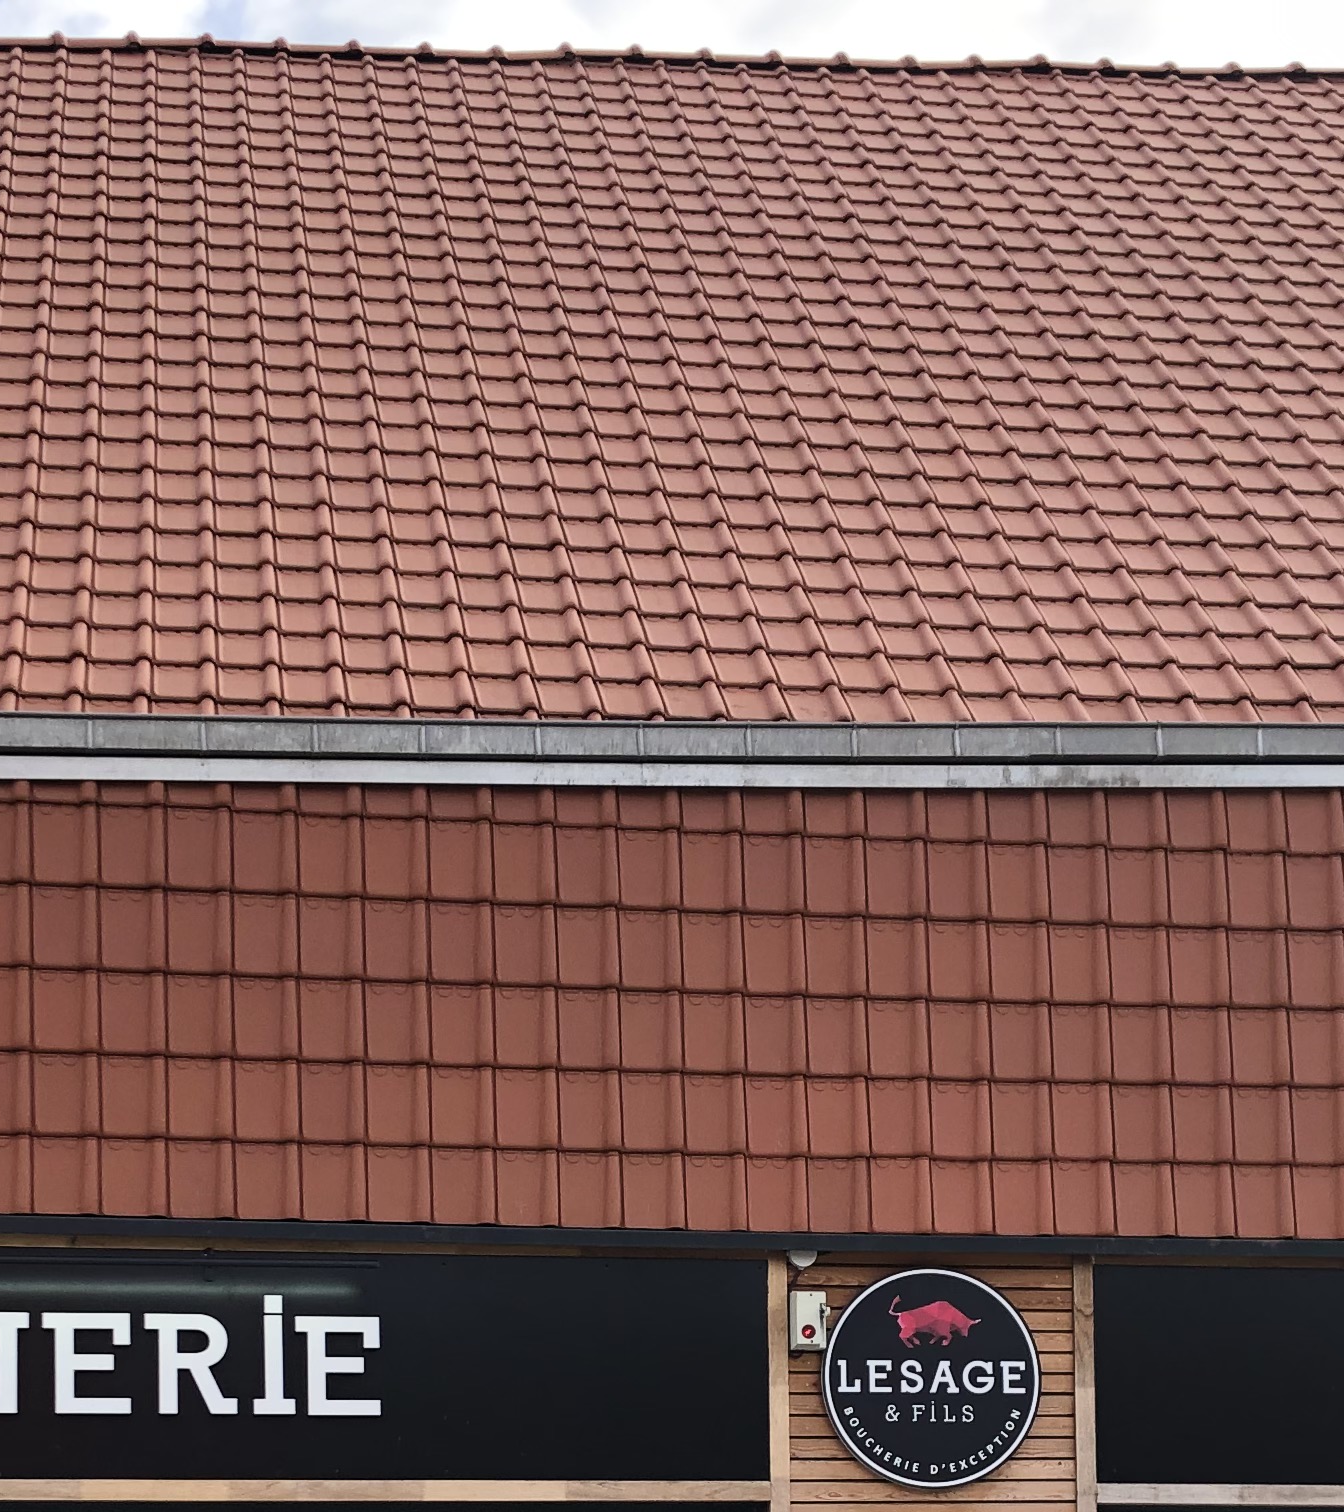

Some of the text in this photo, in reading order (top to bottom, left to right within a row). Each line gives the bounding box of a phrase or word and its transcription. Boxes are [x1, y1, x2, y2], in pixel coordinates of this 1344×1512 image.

[837, 1359, 1027, 1395] LESAGE
[885, 1400, 975, 1423] & FILS
[843, 1405, 1022, 1476] BOUCHERIE D'EXCEPTION
